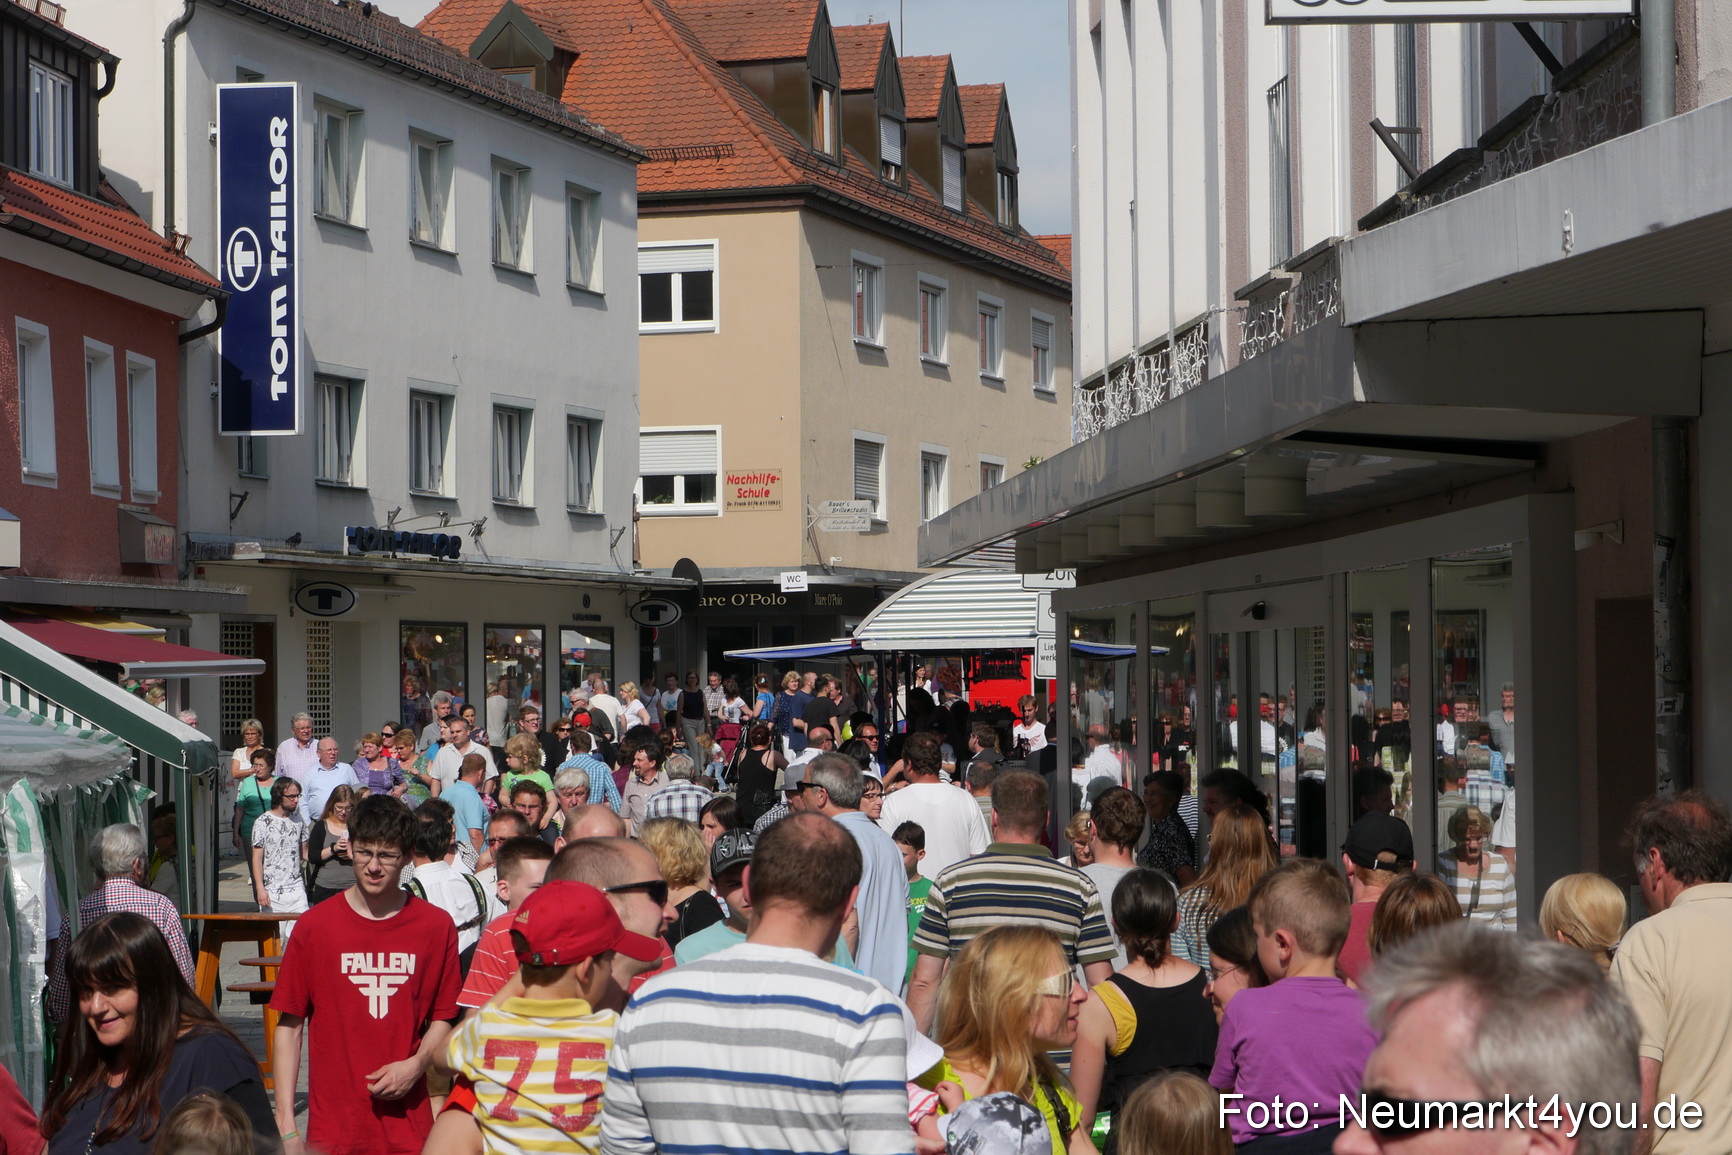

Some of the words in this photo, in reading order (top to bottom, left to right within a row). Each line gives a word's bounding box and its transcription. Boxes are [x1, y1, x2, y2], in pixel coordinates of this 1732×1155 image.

[269, 116, 289, 277] TAILOR
[270, 284, 289, 401] TOM
[726, 472, 781, 486] Nachhilfe-
[736, 486, 771, 499] Schule
[786, 575, 801, 584] WC
[698, 595, 726, 606] arc
[731, 592, 787, 606] O'Polo
[814, 593, 827, 606] Marc
[340, 952, 416, 975] FALLEN
[482, 1038, 606, 1133] 75
